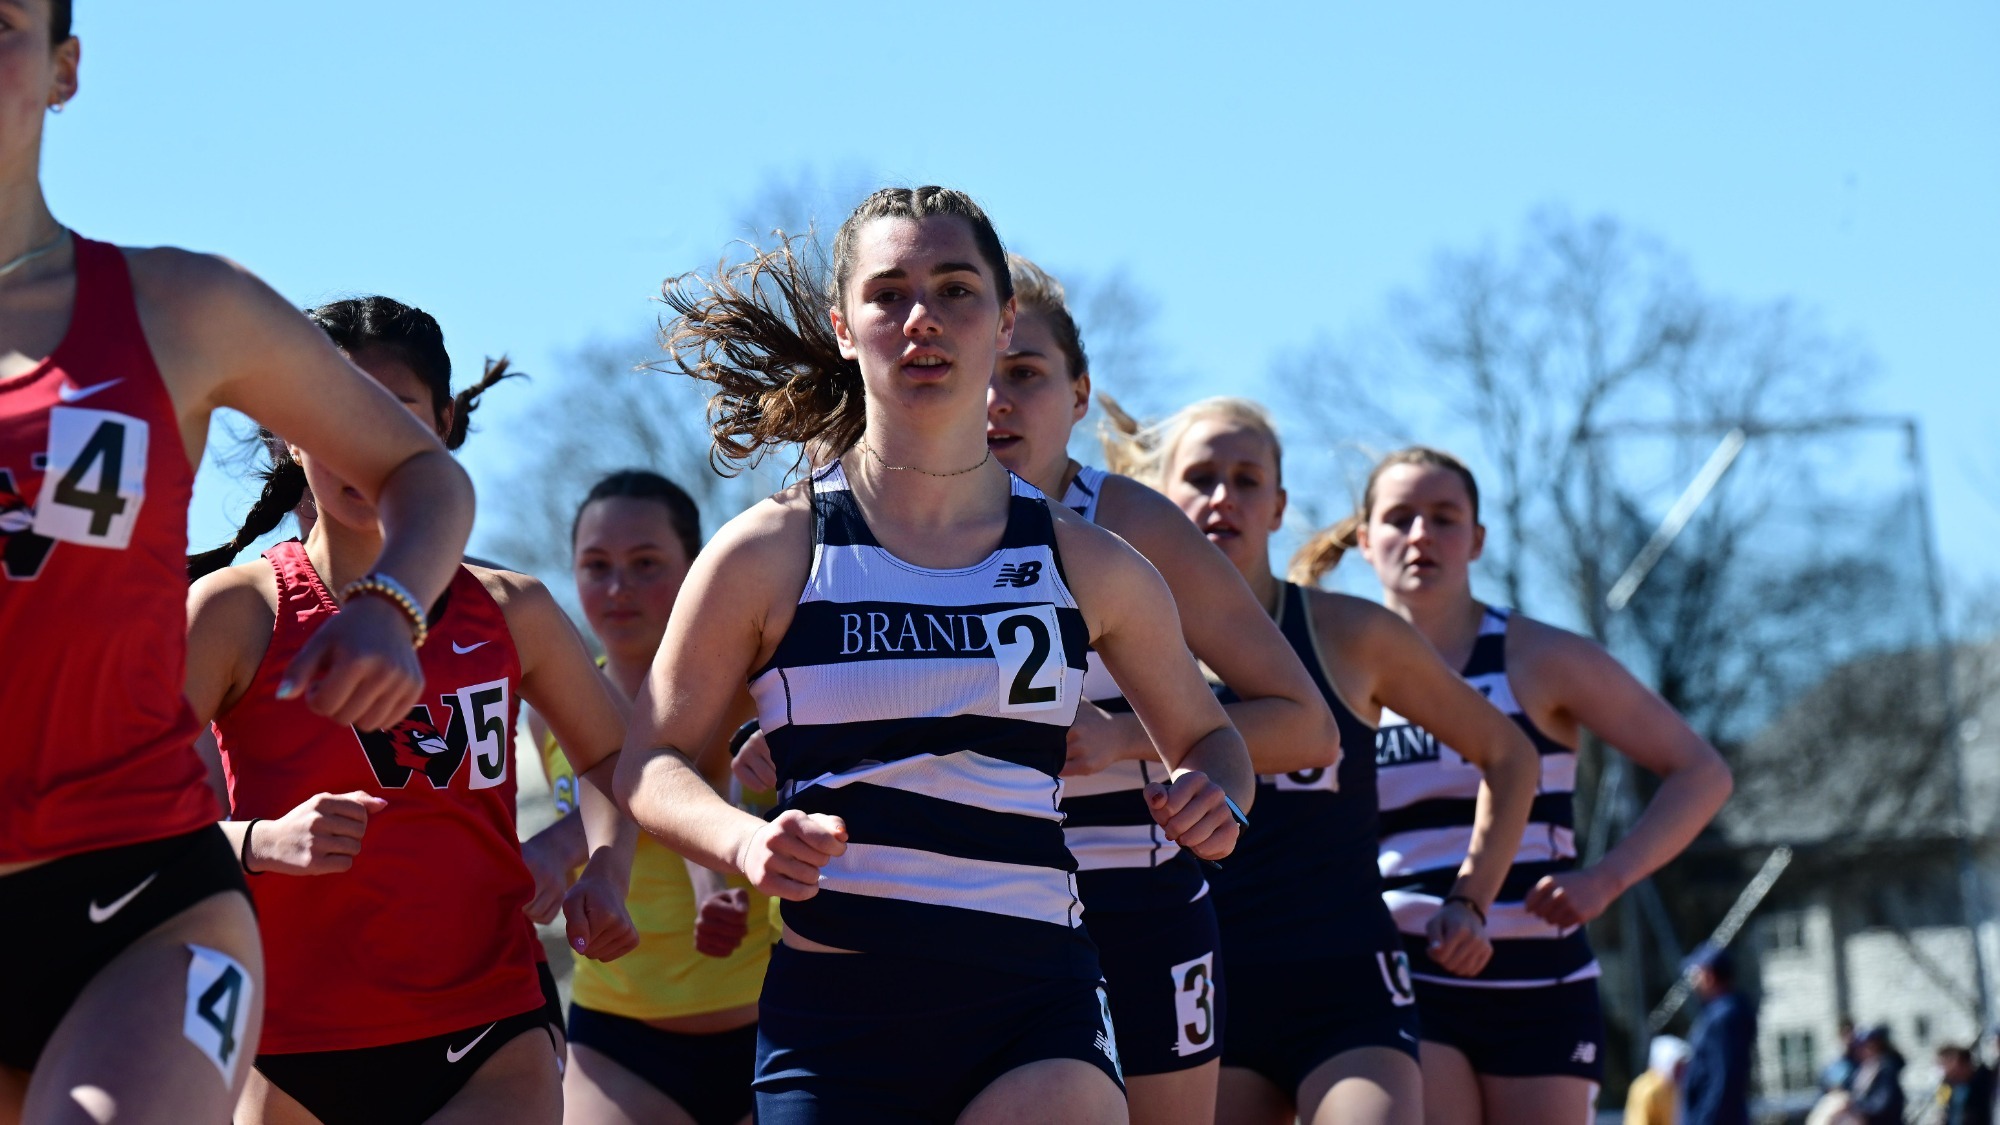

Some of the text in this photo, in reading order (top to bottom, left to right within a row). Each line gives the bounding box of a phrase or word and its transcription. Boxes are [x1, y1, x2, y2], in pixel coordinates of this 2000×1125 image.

[53, 419, 127, 537] 4
[997, 614, 1056, 705] 2
[470, 686, 505, 780] 5
[196, 964, 242, 1066] 4
[1183, 963, 1211, 1046] 3
